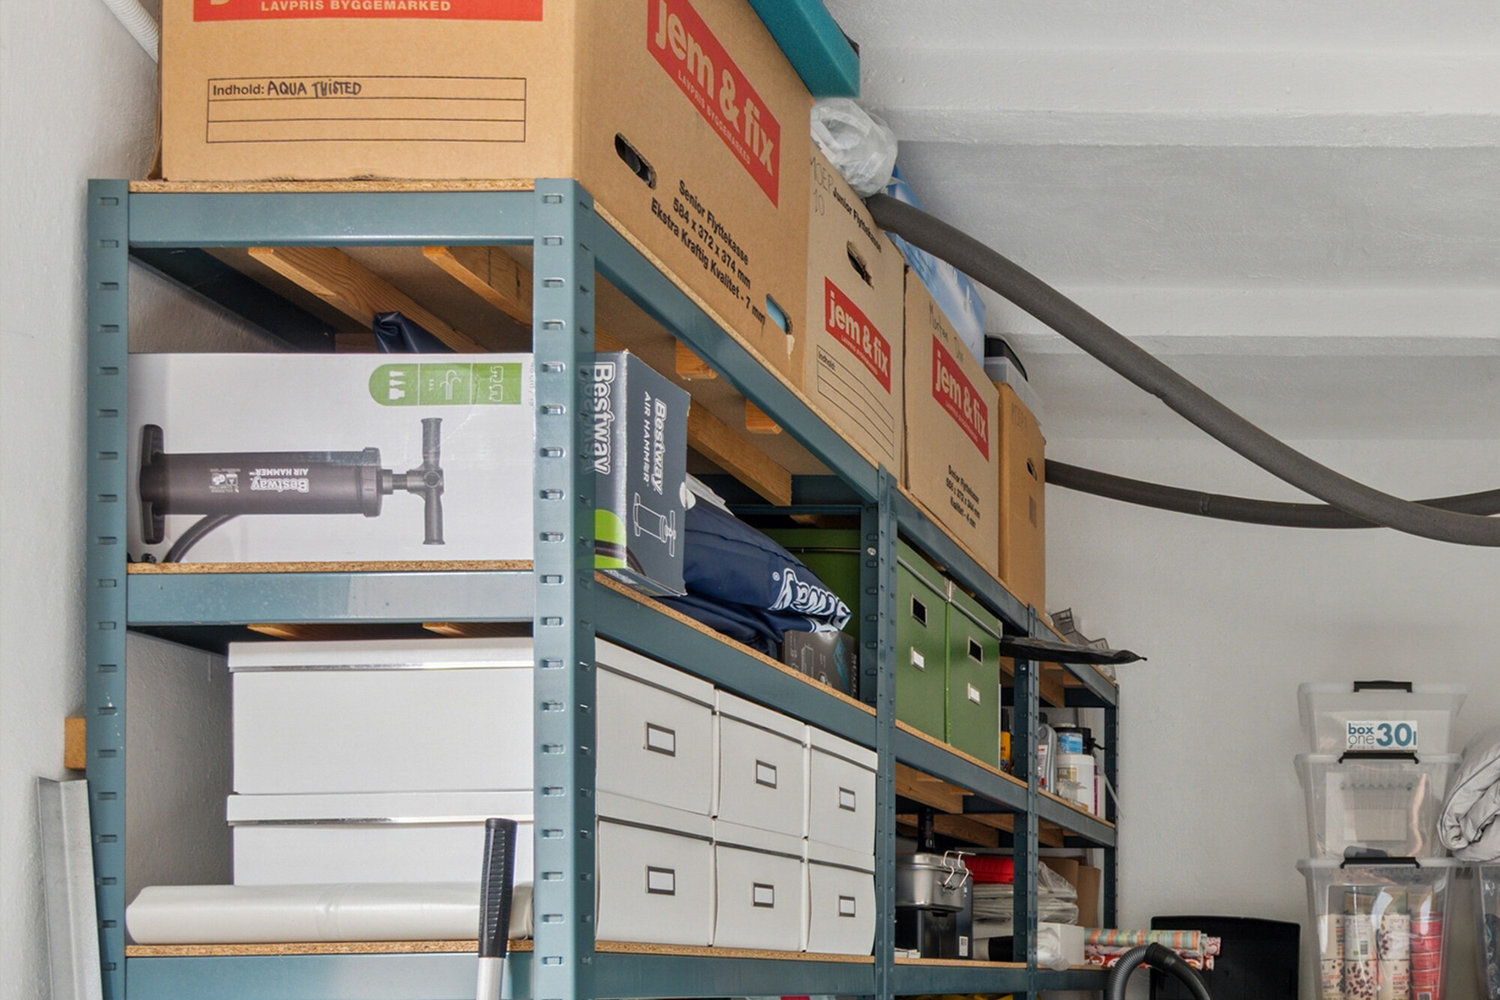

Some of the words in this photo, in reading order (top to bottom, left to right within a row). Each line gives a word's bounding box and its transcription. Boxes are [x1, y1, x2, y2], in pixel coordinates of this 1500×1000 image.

[261, 0, 324, 12] LAVPRIS
[332, 0, 452, 12] BYGGEMARKED
[213, 84, 265, 96] Indhold:
[267, 80, 307, 96] AQUA
[655, 1, 715, 100] jem
[719, 68, 740, 133] &
[744, 97, 774, 177] fix
[673, 197, 689, 224] 584
[698, 227, 714, 249] 372
[721, 250, 737, 272] 374
[679, 180, 705, 217] Senior
[707, 212, 749, 266] Flyttekasse
[651, 197, 680, 237] Ekstra
[681, 230, 709, 270] Kraftig
[710, 257, 740, 300] Kvalitet
[829, 290, 861, 346] jem
[873, 336, 889, 378] fix
[644, 391, 653, 417] AIR
[935, 350, 962, 410] jem
[973, 399, 987, 443] fix
[642, 419, 652, 482] HAMMER
[651, 398, 667, 496] Bestway
[249, 476, 310, 494] Bestway
[292, 468, 309, 476] AIR
[1348, 722, 1374, 735] box
[1348, 735, 1375, 745] one
